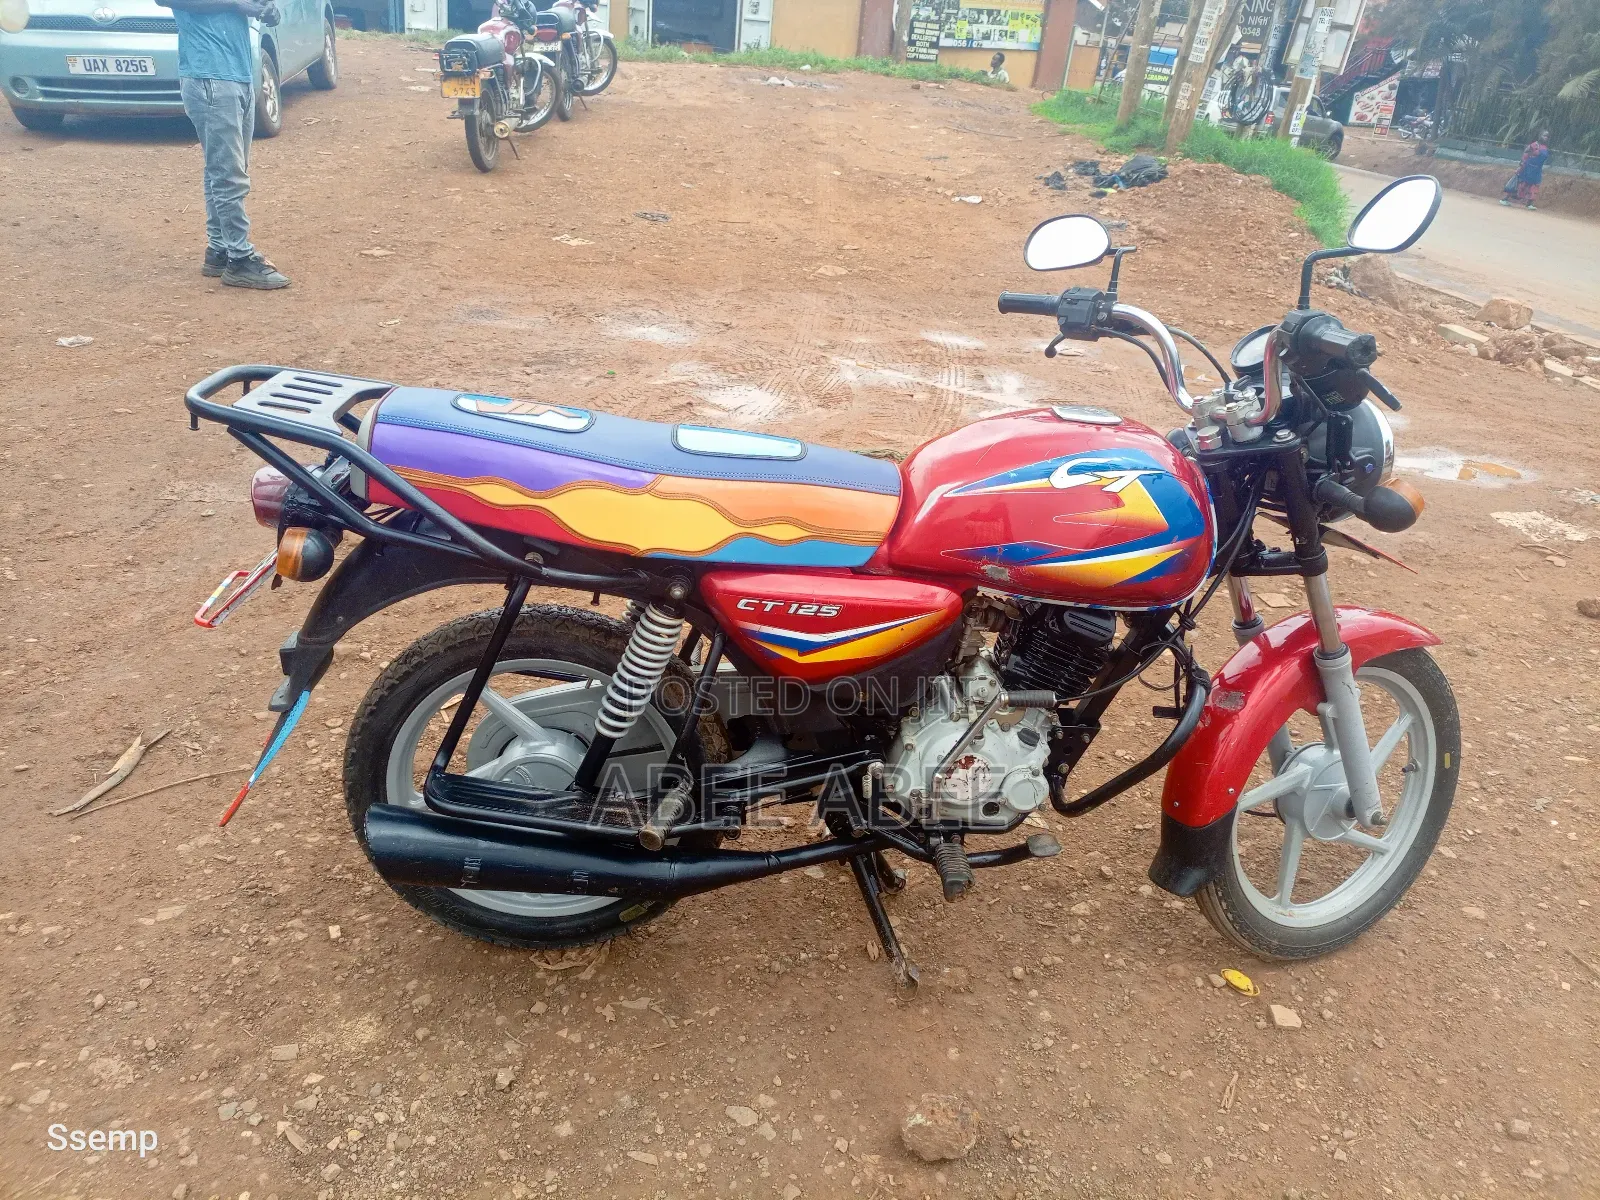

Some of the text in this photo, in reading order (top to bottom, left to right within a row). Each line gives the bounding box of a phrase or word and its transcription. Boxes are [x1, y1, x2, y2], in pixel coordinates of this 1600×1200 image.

[1247, 15, 1271, 26] NIGH
[82, 58, 149, 73] UAX 825G
[737, 598, 841, 617] CT 125
